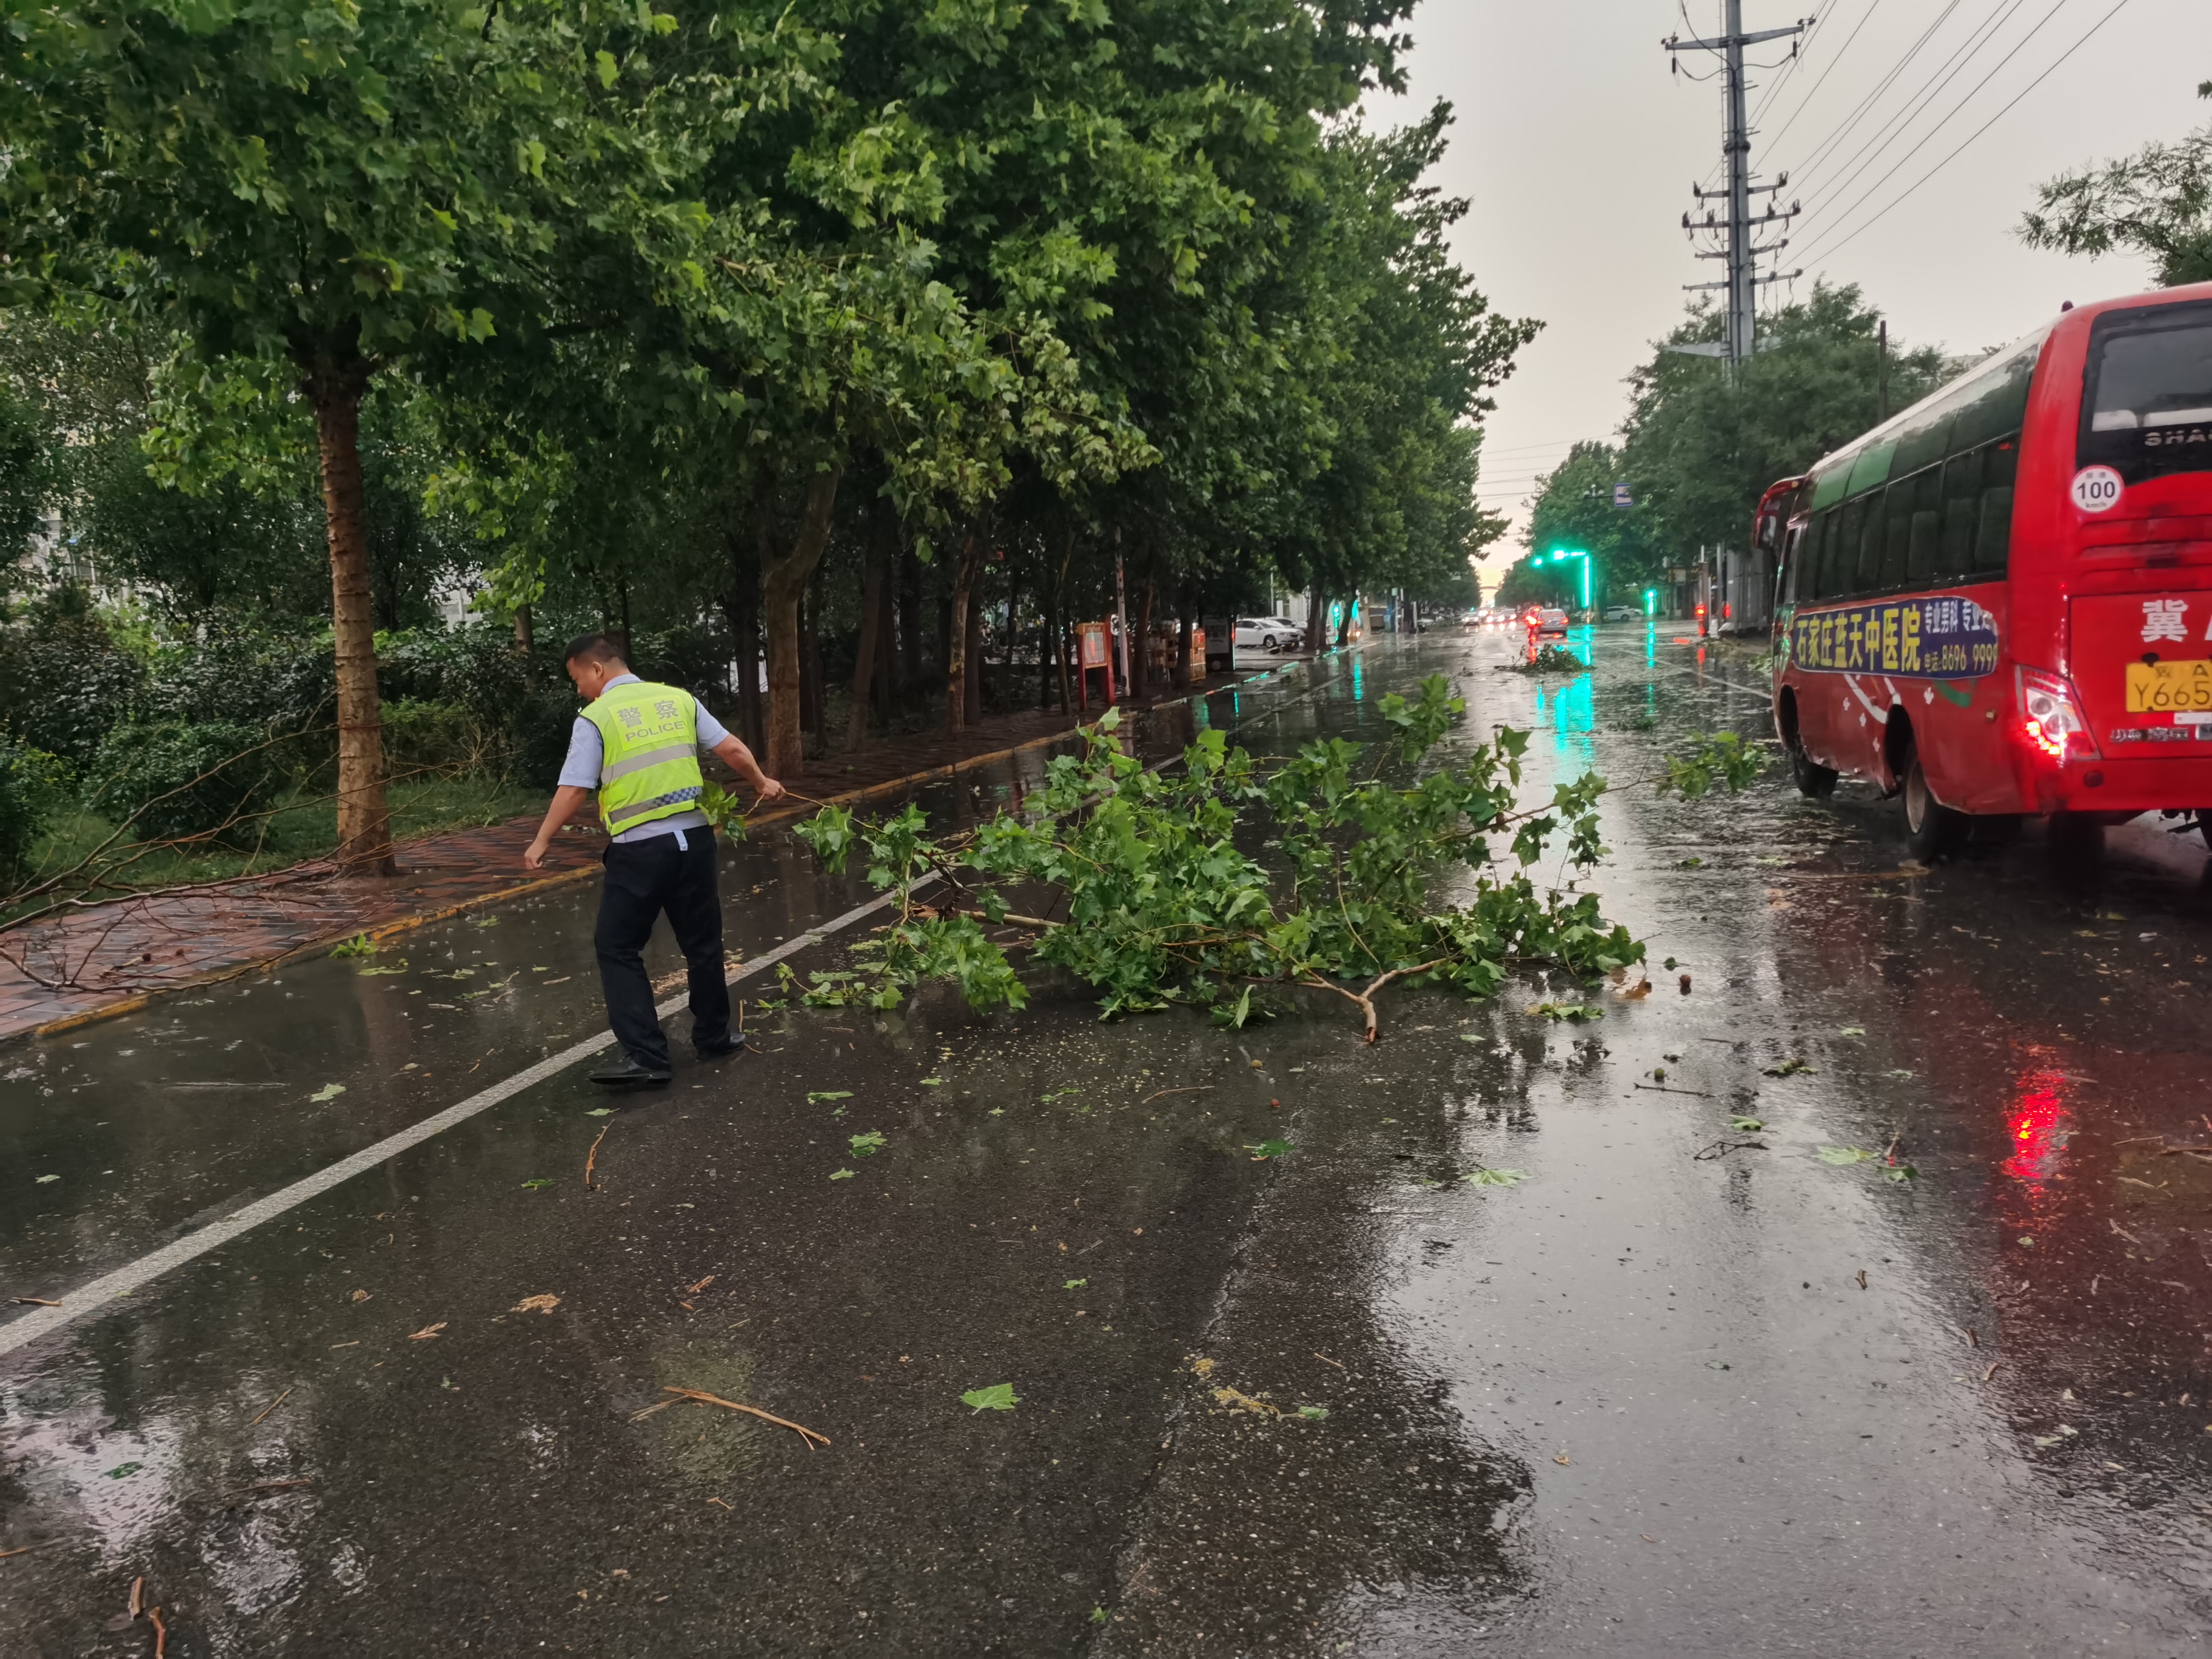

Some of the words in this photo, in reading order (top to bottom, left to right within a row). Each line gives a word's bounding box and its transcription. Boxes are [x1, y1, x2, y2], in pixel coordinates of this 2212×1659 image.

[2077, 481, 2116, 500] 100
[1795, 603, 1921, 672] 石家庄蓝天中医院
[625, 720, 685, 742] POLICE
